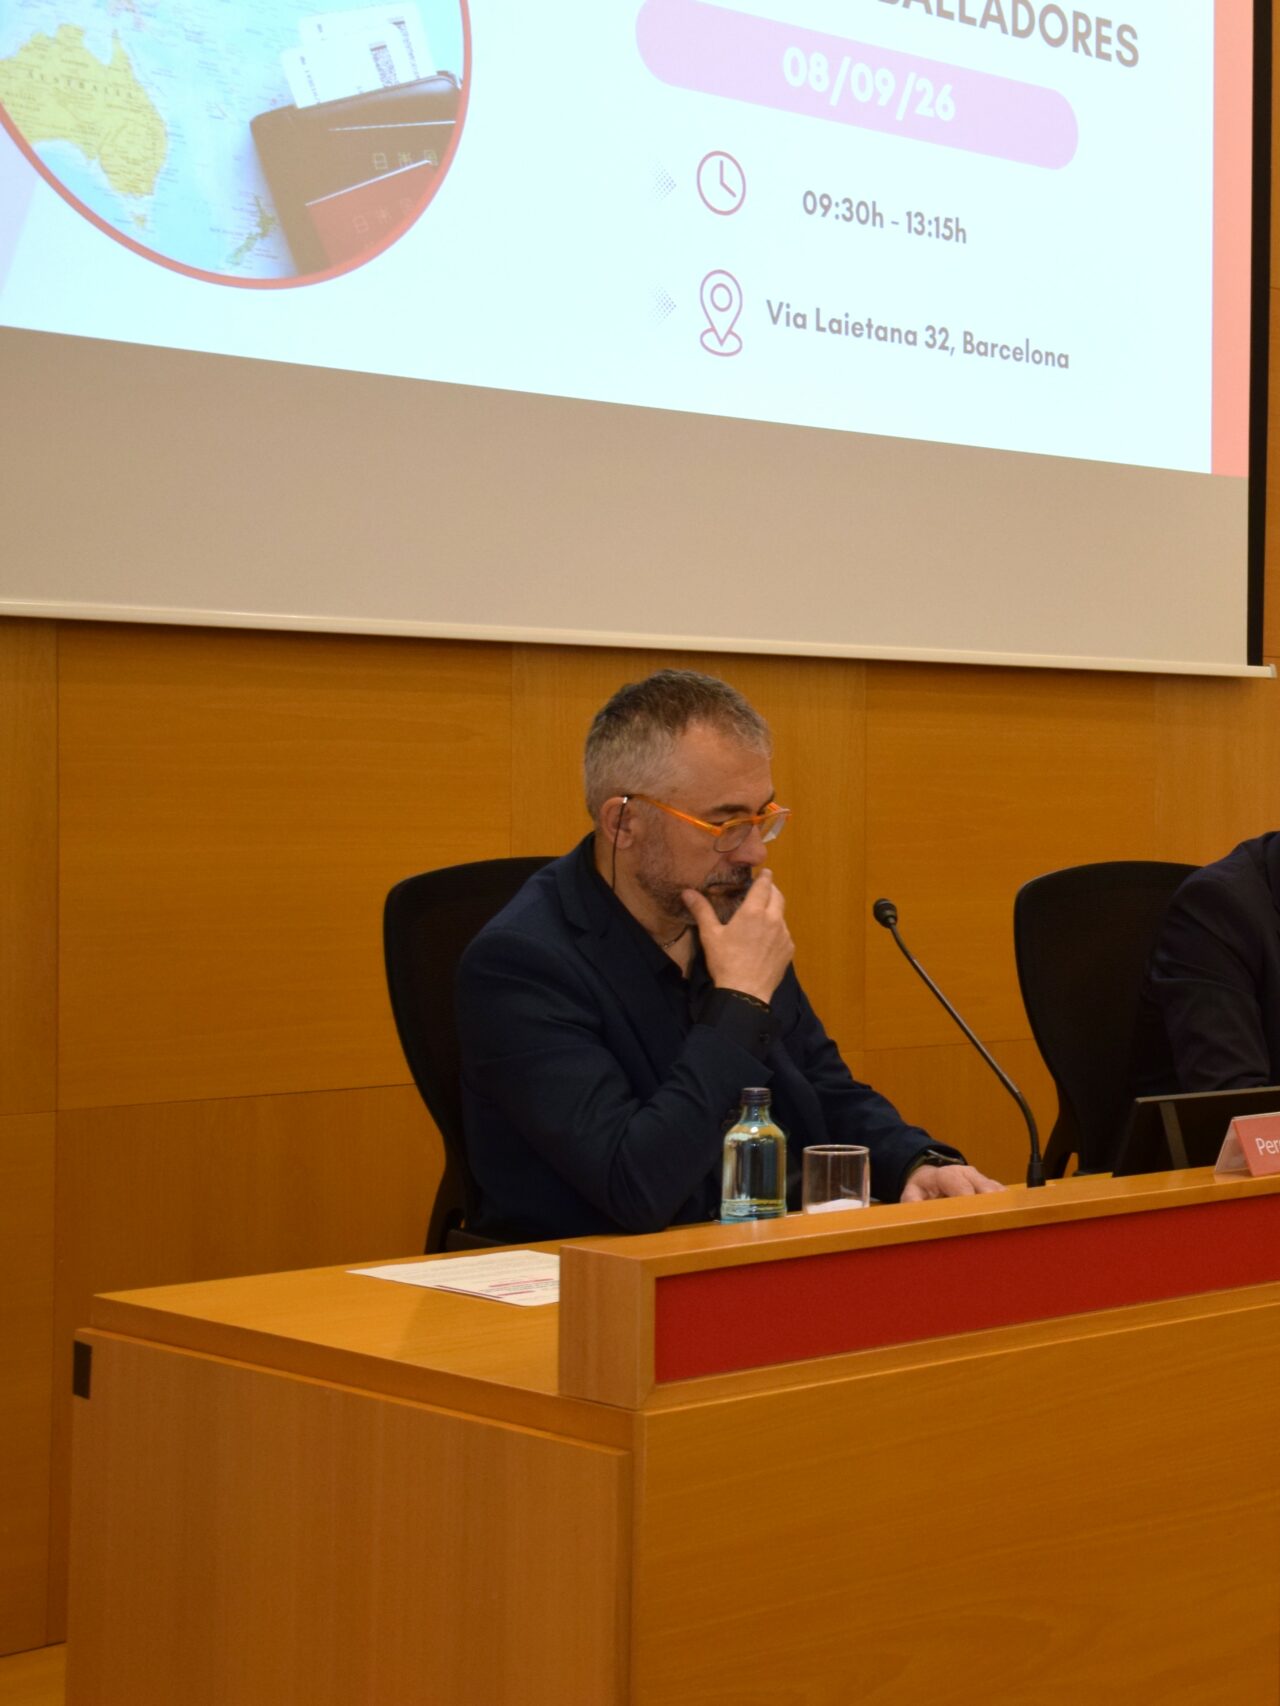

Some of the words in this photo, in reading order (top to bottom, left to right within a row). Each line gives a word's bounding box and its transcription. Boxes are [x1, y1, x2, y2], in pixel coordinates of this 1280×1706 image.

[876, 0, 1139, 68] LLADORES
[782, 46, 957, 122] 08/09/26
[802, 190, 884, 229] 09:30h
[905, 210, 967, 244] 13:15h
[766, 299, 808, 330] Via
[815, 307, 918, 347] Laietana
[924, 324, 956, 357] 32,
[962, 330, 1070, 369] Barcelona
